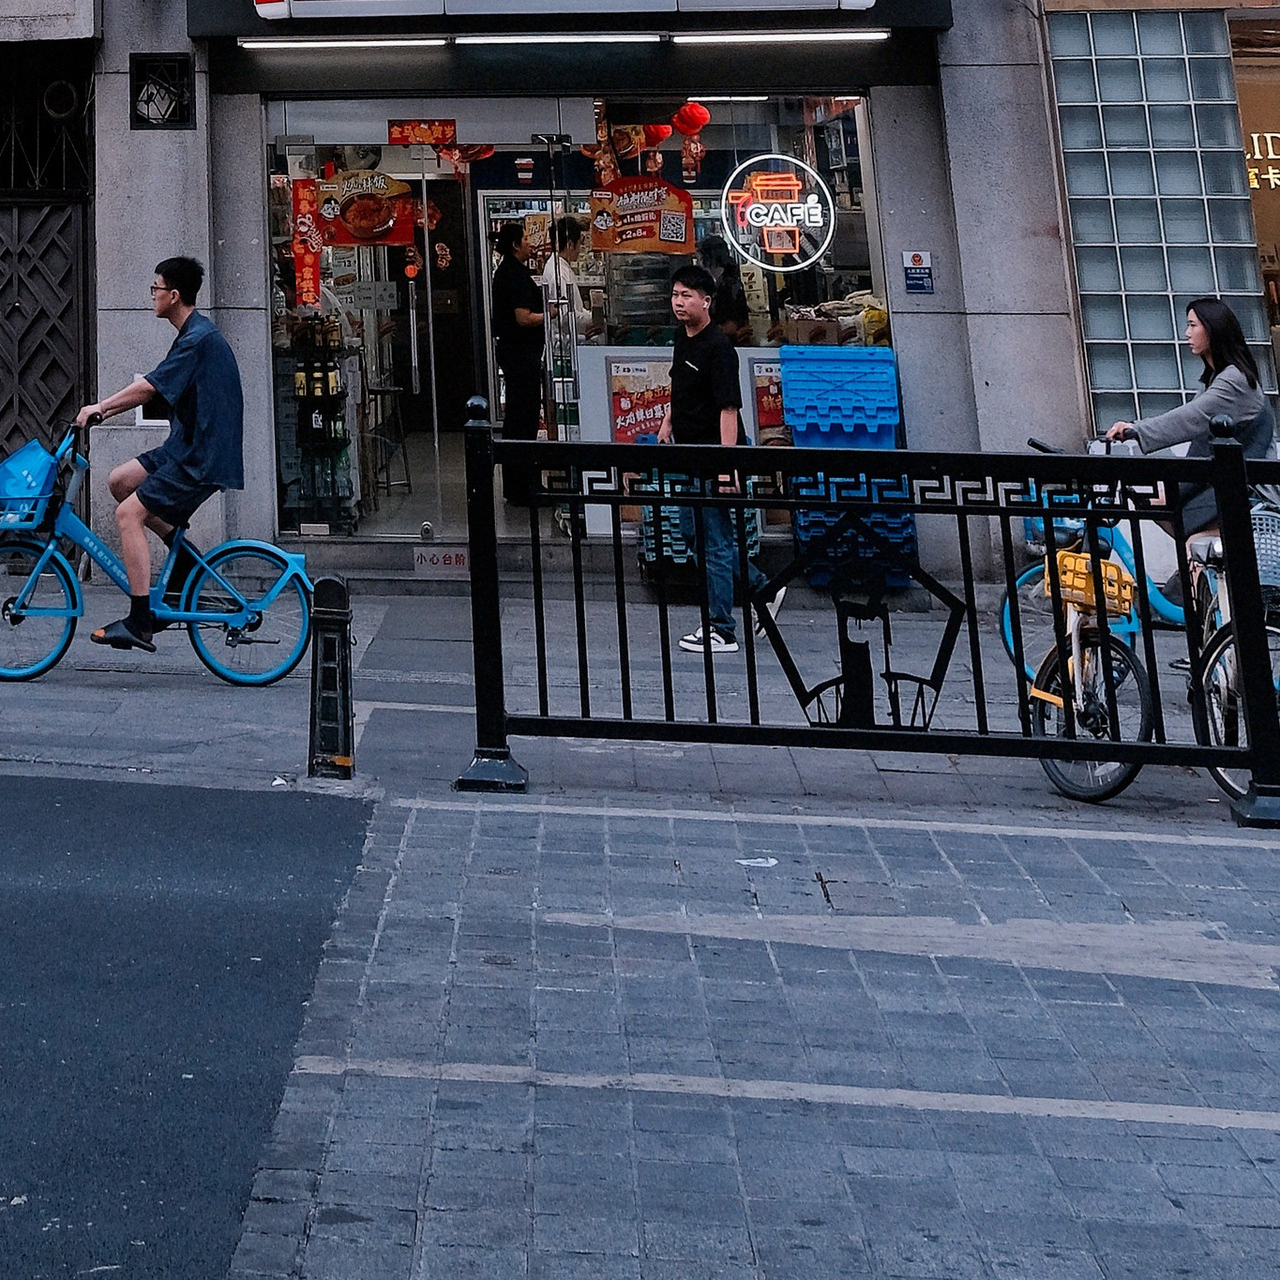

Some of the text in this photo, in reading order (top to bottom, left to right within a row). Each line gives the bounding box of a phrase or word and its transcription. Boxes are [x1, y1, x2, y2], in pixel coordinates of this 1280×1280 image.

[746, 193, 824, 227] CAFÉ
[416, 553, 466, 566] 小心台阶
